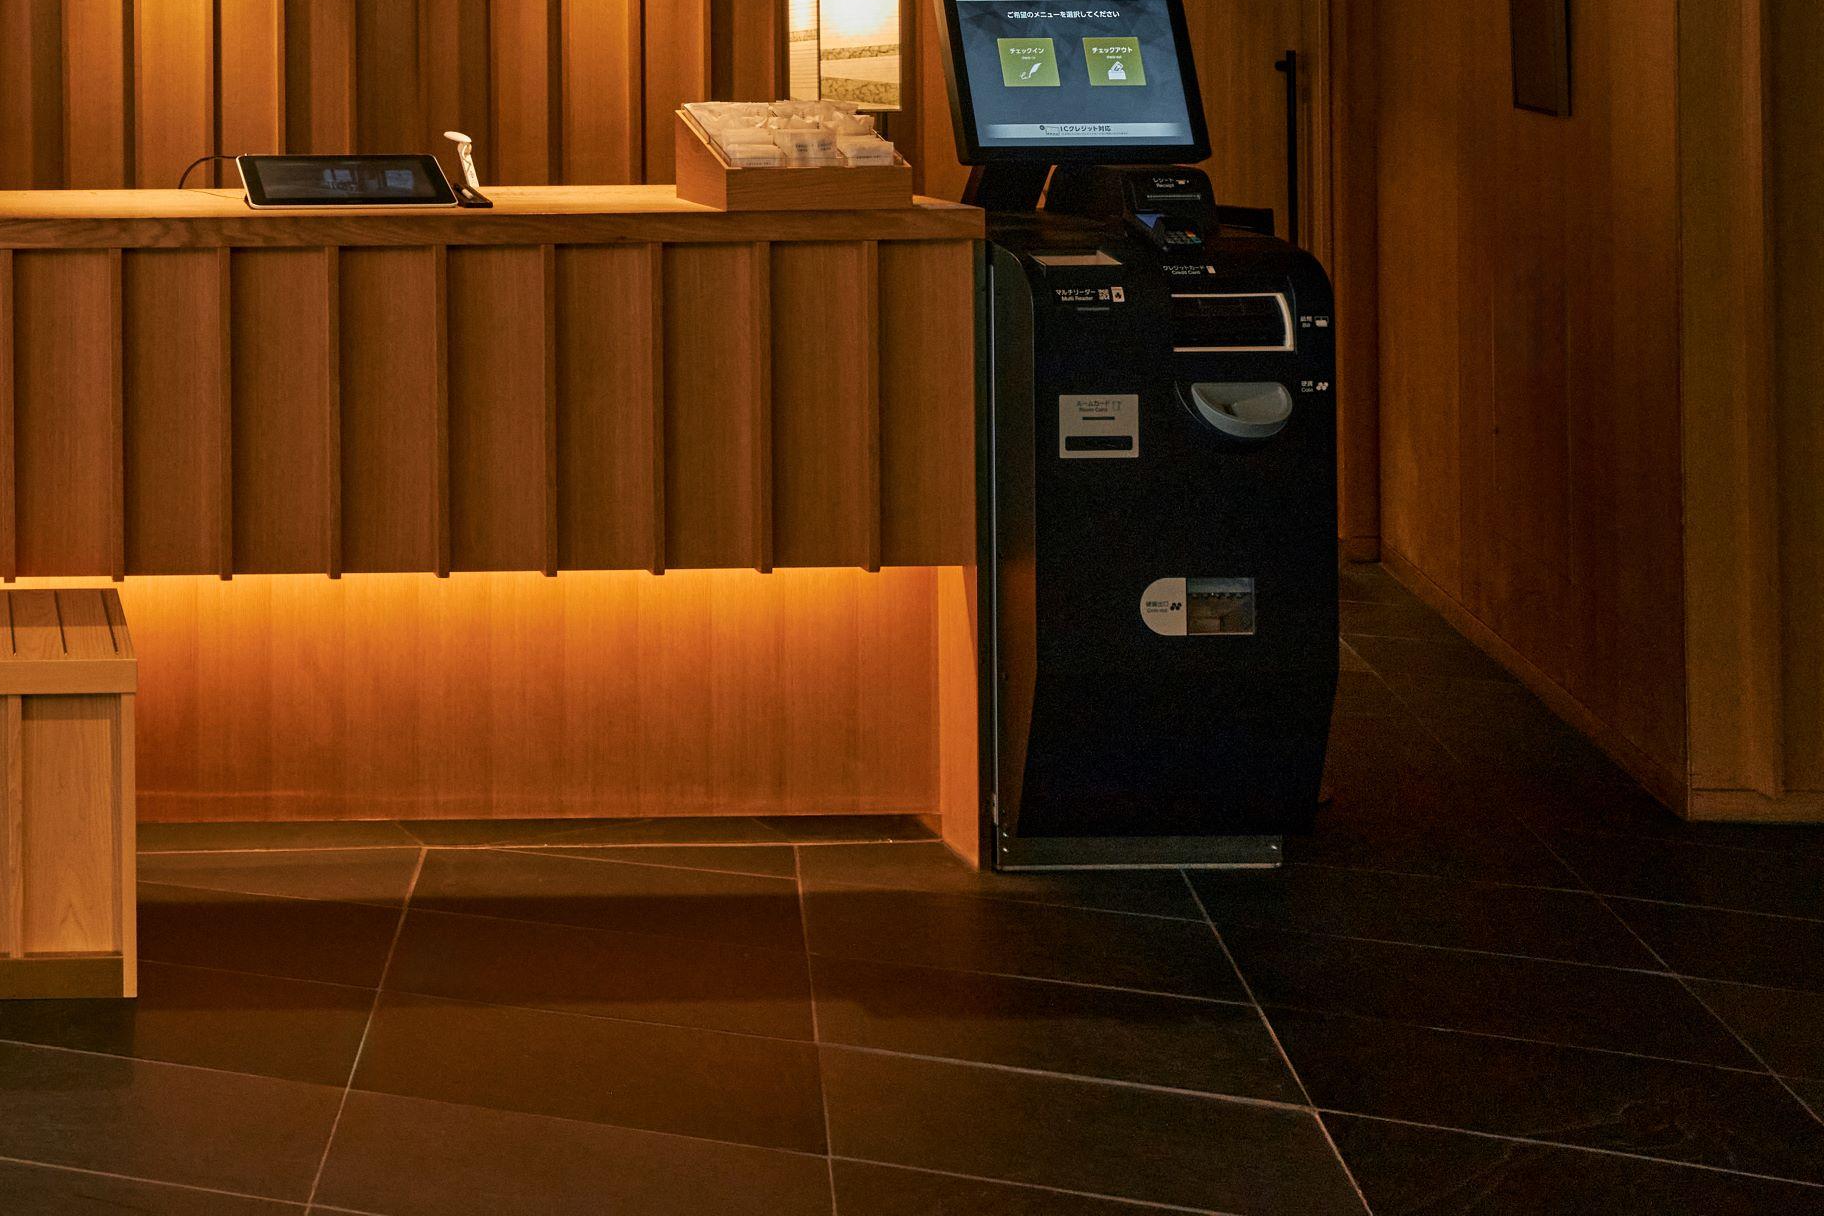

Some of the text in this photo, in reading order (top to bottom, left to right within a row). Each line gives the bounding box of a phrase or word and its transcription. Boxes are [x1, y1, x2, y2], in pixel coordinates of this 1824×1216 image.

[1007, 10, 1120, 19] ご希望のメニューを選択してください
[1091, 46, 1133, 54] チェックアウト
[1056, 288, 1096, 296] マルチリーダー
